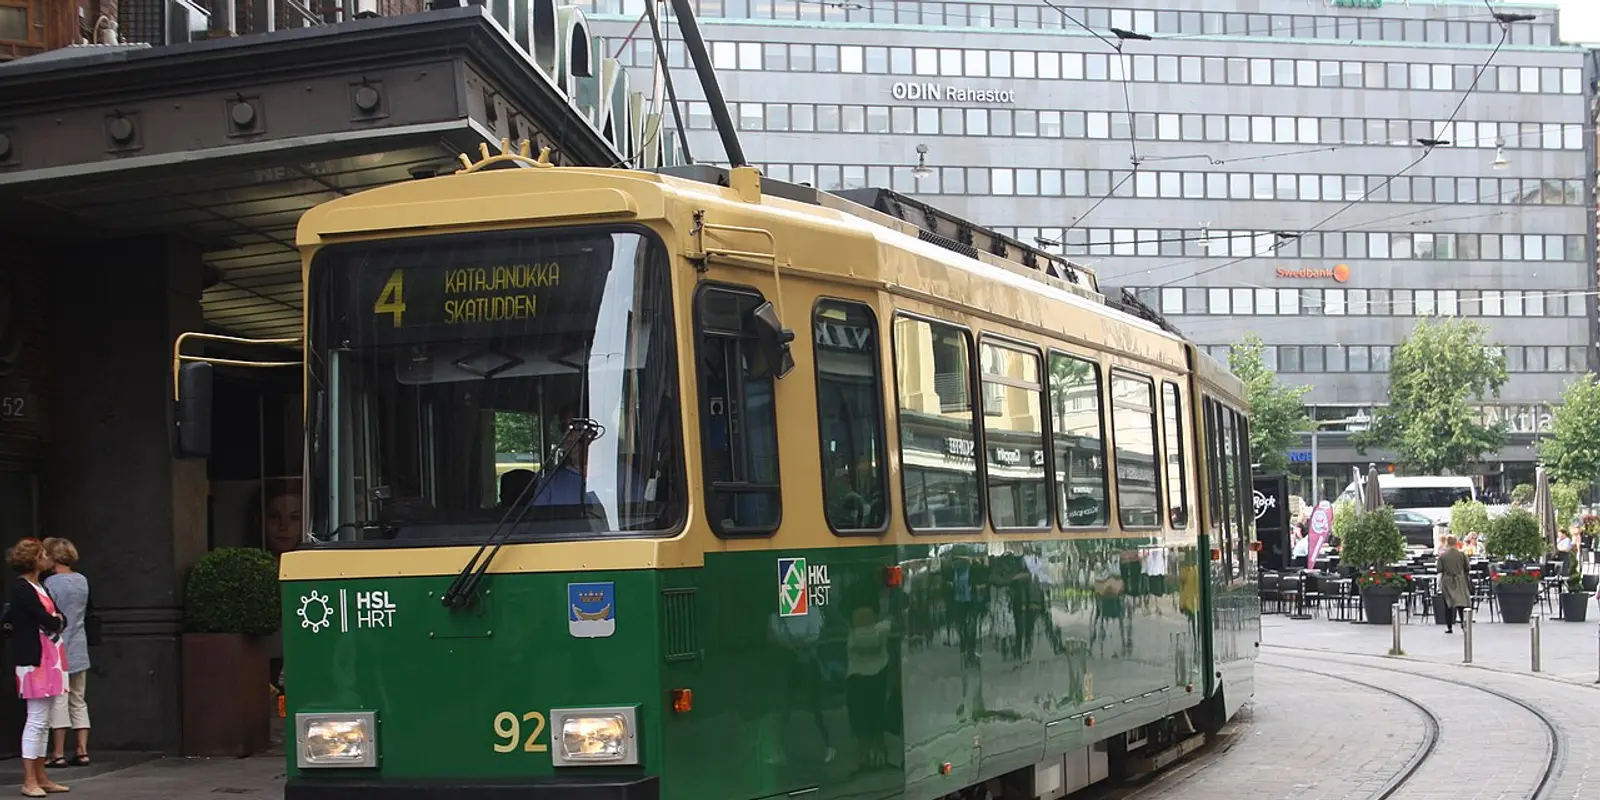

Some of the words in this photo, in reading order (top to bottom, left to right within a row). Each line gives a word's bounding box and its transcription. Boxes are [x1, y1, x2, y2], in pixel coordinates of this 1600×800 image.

[892, 81, 940, 100] ODIN
[946, 86, 1015, 102] Rahastot
[445, 262, 560, 294] KATAJANOKKA
[1276, 267, 1333, 278] Swedbank
[374, 269, 406, 328] 4
[444, 294, 537, 324] SKATUDDEN
[3, 397, 24, 416] 52
[1484, 407, 1553, 433] Aktia
[1253, 495, 1276, 508] Rock
[807, 564, 831, 585] HKL
[357, 591, 396, 609] HSL
[809, 585, 831, 606] HST
[357, 609, 396, 628] HRT
[493, 711, 547, 753] 92
